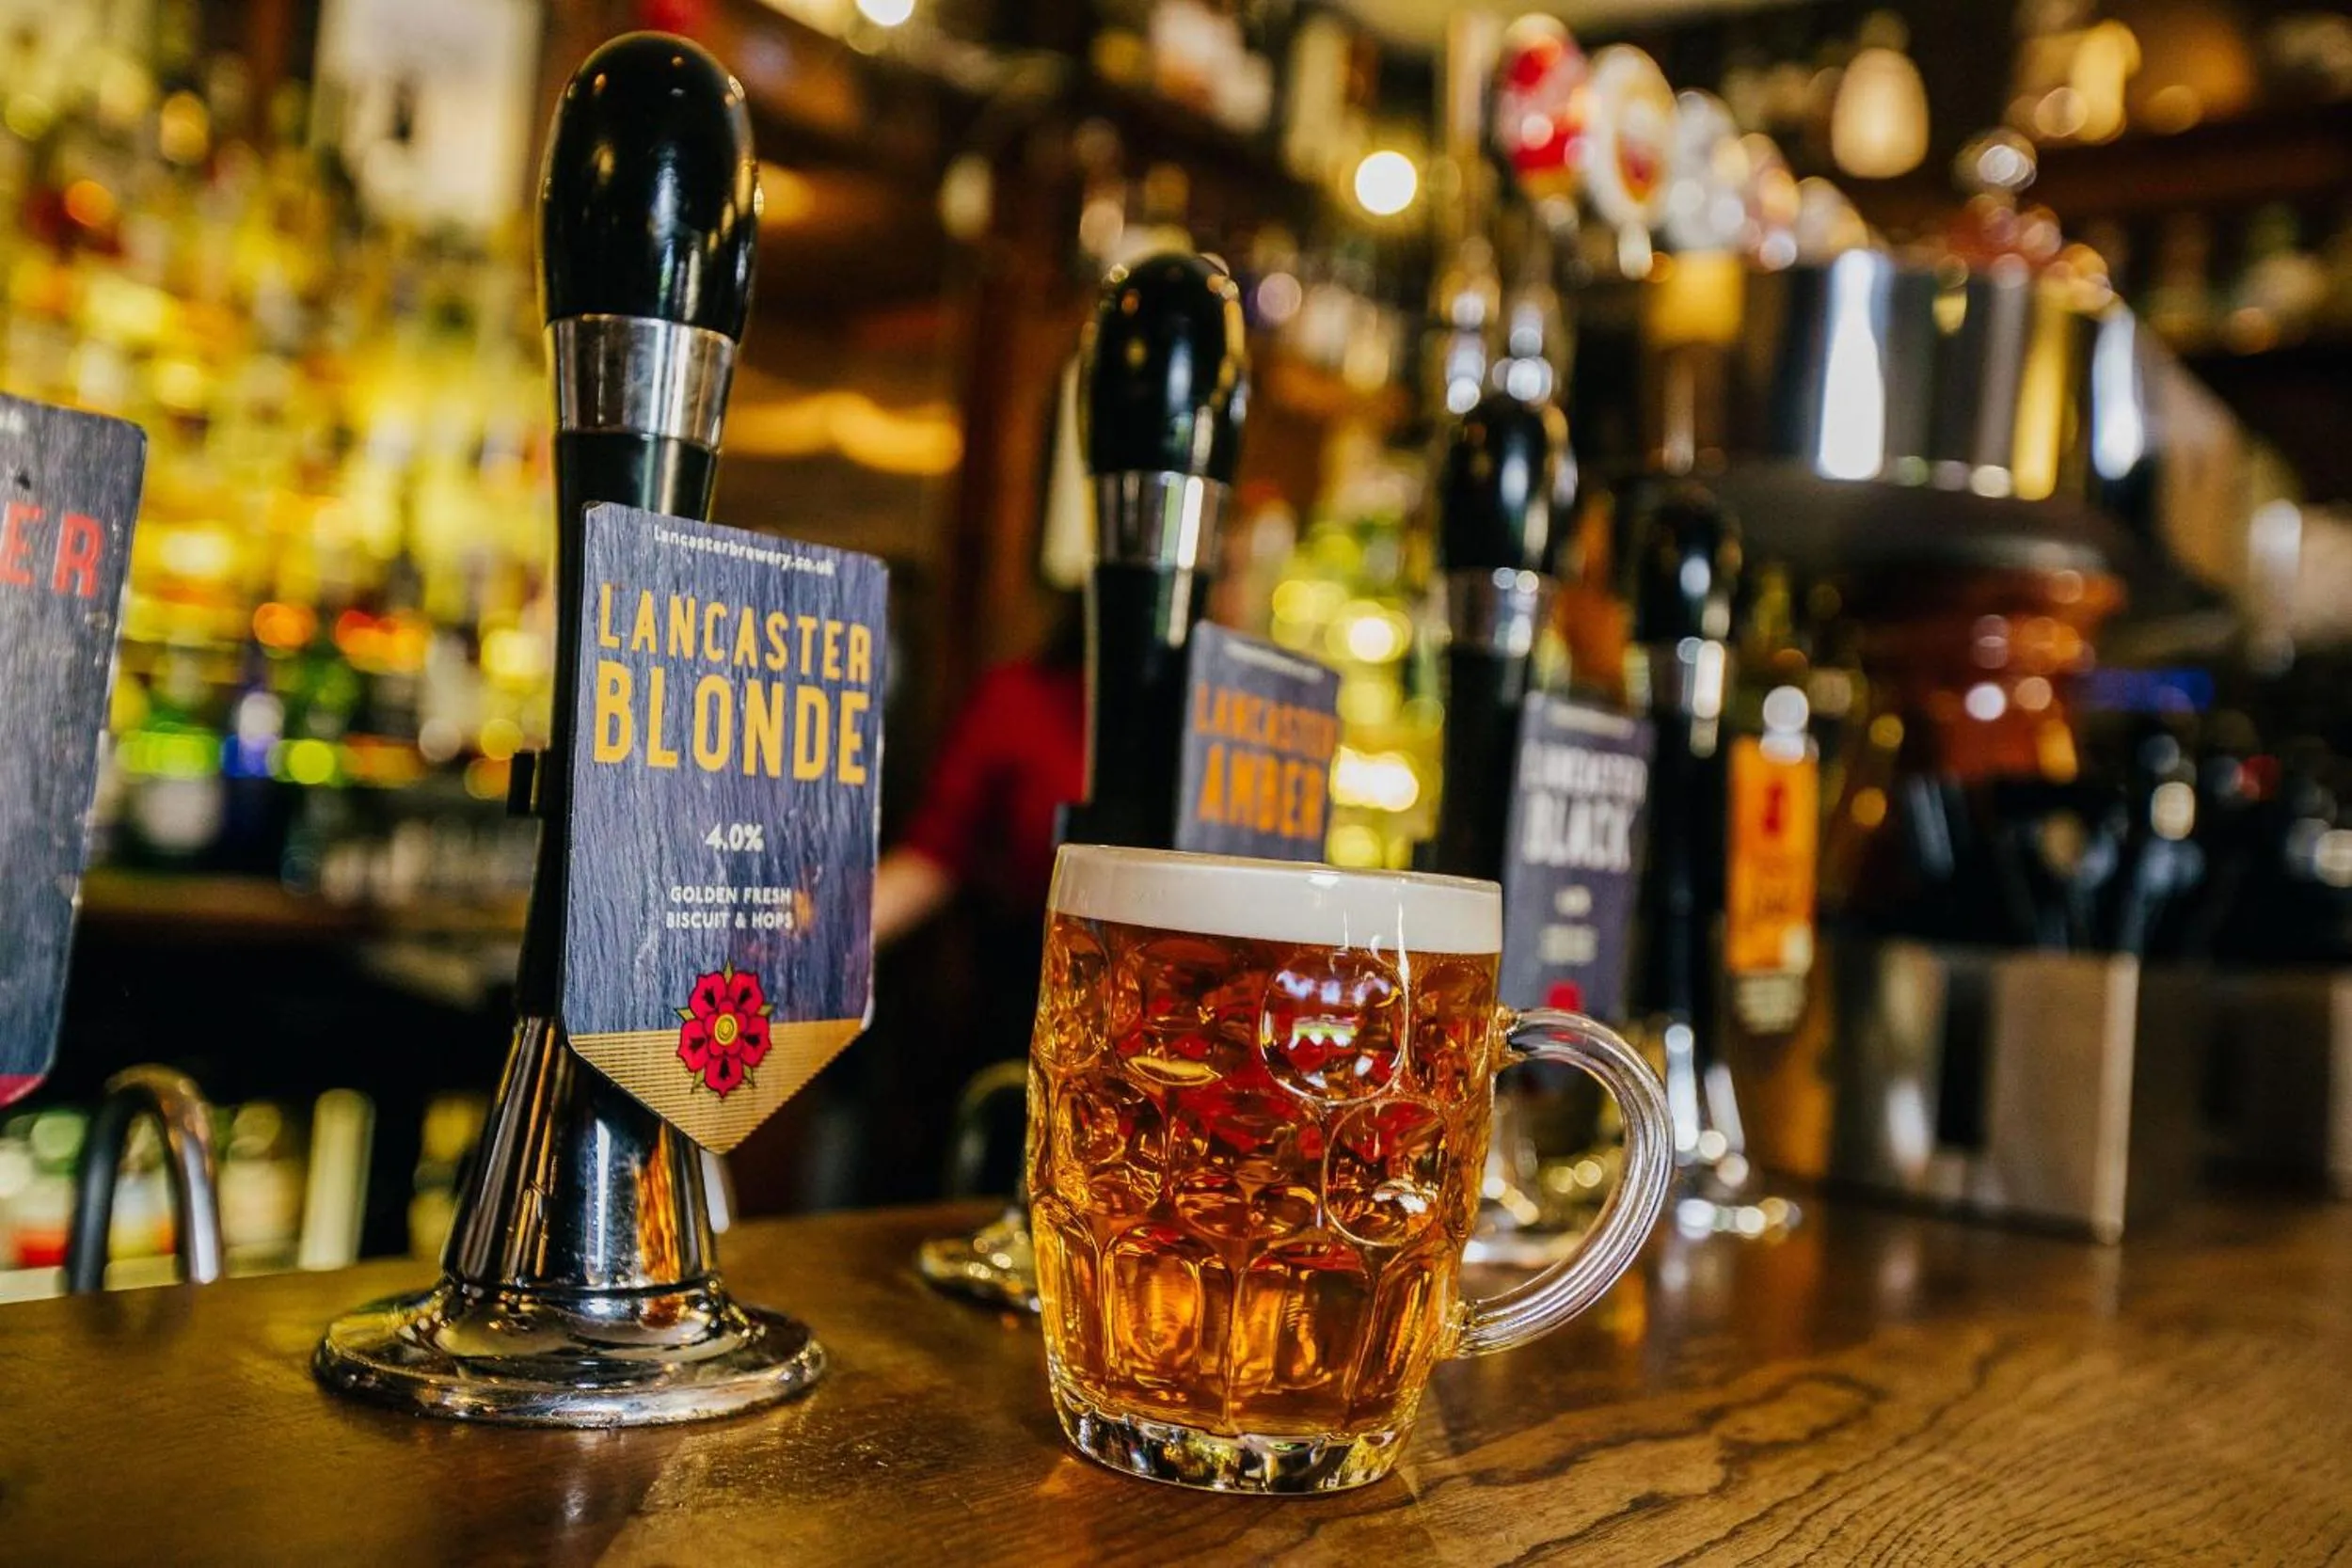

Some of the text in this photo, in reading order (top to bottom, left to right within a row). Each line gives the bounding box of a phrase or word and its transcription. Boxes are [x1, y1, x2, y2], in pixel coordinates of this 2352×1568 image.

[598, 582, 873, 685] LANCASTER
[593, 659, 870, 784] BLONDE
[1197, 742, 1323, 840] AMBER
[705, 823, 764, 852] 4.0%
[665, 911, 794, 929] BISCUIT & HOPS
[670, 885, 792, 906] GOLDEN FRESH
